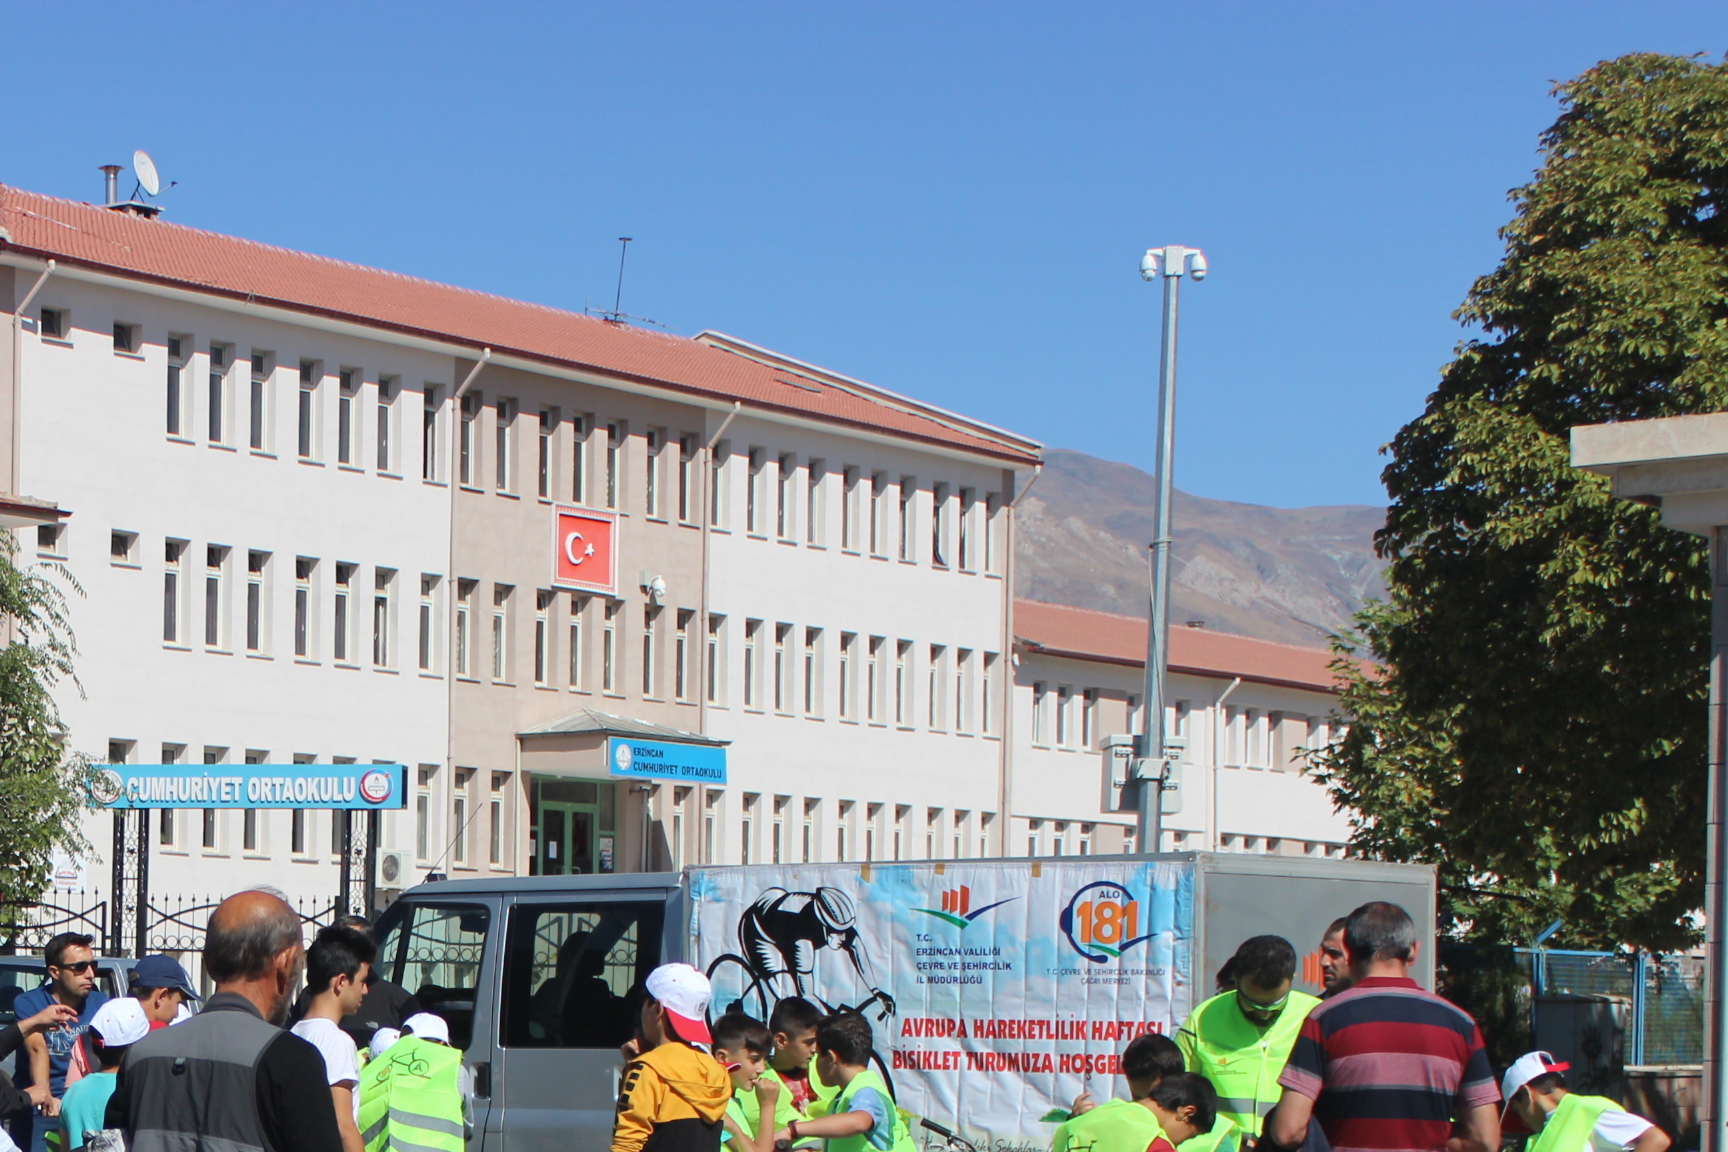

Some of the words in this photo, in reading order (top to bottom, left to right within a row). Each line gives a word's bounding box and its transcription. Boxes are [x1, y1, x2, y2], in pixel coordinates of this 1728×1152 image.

[633, 745, 664, 758] ERZİNCAN
[633, 762, 678, 775] CUMHURİYET
[681, 766, 722, 779] ORTAOKULU
[127, 772, 243, 803] CUMHURİYET
[247, 776, 356, 803] ORTAOKULU
[1099, 890, 1120, 899] ALO
[1076, 900, 1139, 944] 181
[916, 934, 932, 942] T.C.
[916, 947, 961, 957] ERZİNCAN
[962, 947, 1001, 957] VALİLİĞİ
[916, 961, 944, 971] ÇEVRE
[946, 962, 959, 970] VE
[961, 960, 1012, 971] ŞEHİRCİLİK
[1061, 968, 1081, 977] ÇEVRE
[916, 974, 925, 984] İL
[927, 974, 983, 985] MÜDÜRLÜĞÜ
[901, 1018, 967, 1038] AVRUPA
[974, 1014, 1087, 1040] HAREKETLİLİK
[1091, 1020, 1163, 1041] HAFTASI
[893, 1044, 961, 1070] BİSİKLET
[966, 1051, 1054, 1073] TURUMUZA
[1059, 1053, 1125, 1080] HOŞGEL
